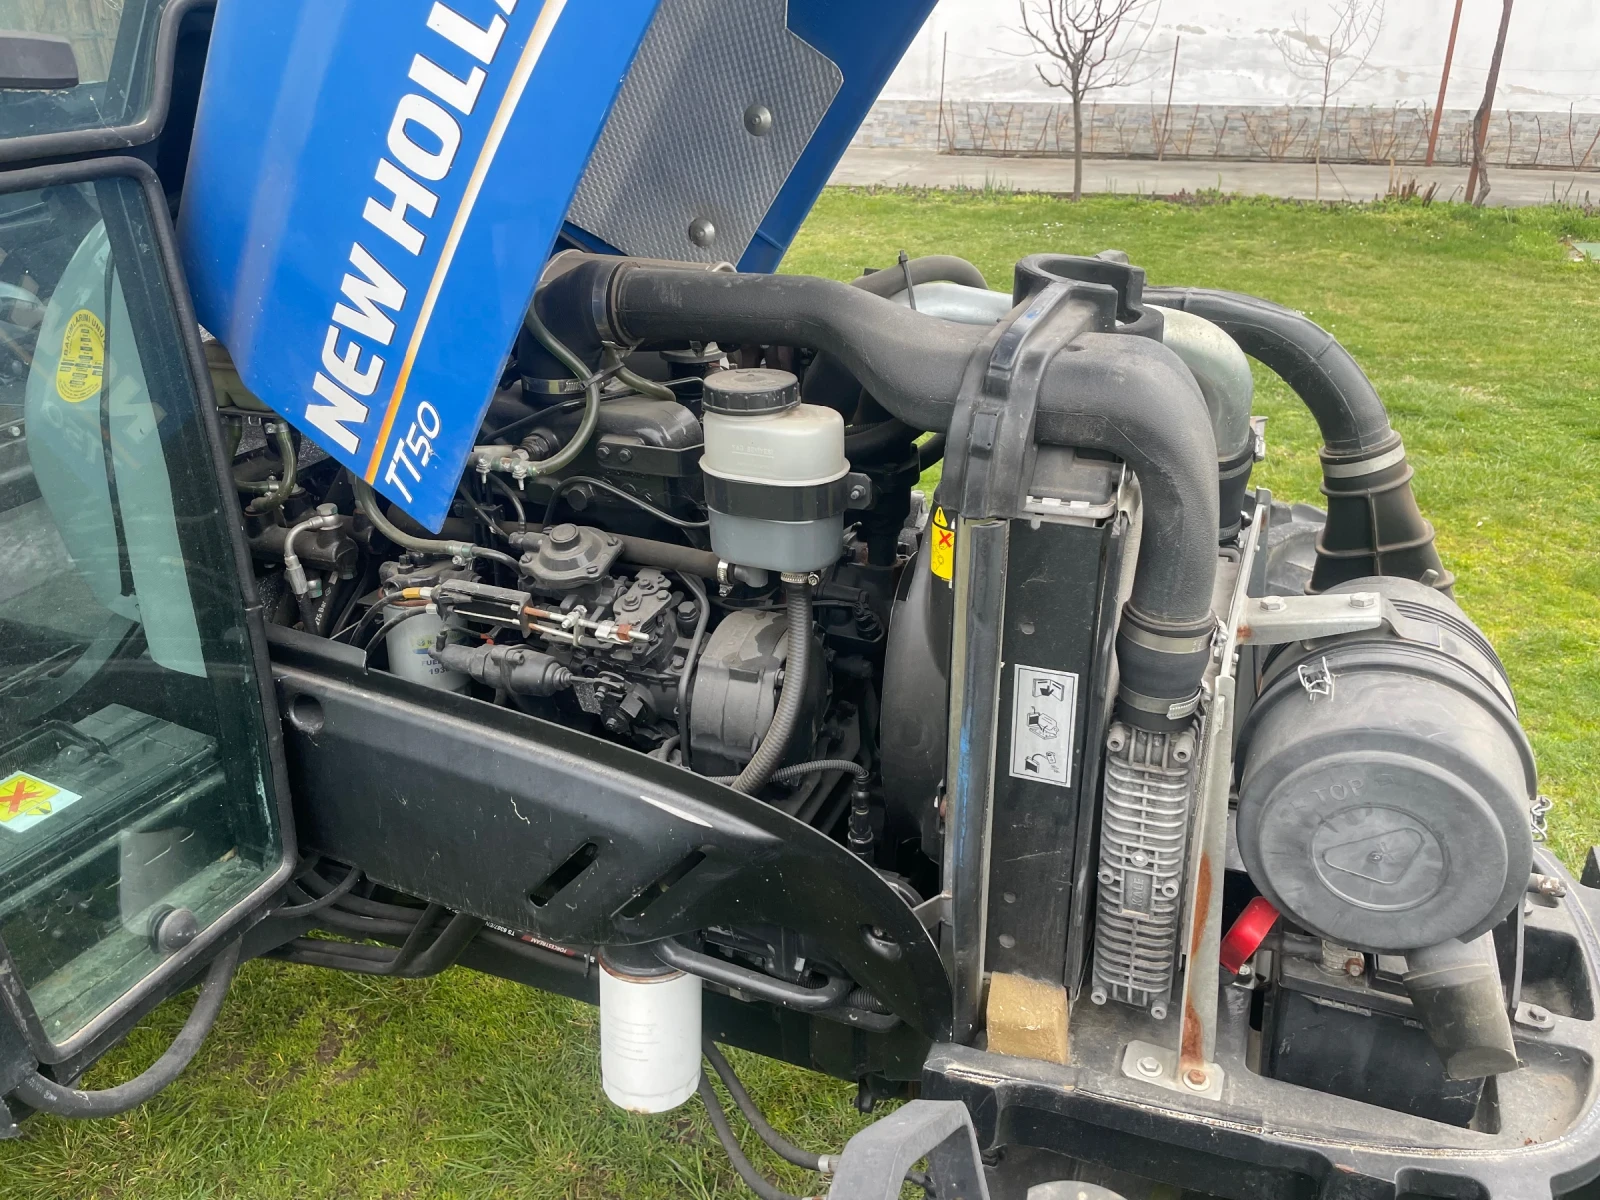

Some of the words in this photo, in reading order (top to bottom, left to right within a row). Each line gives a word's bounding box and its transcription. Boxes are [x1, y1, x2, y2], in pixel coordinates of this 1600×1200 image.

[305, 241, 408, 455] NEW
[362, 0, 518, 256] HOLL
[384, 400, 441, 504] TT50
[1309, 779, 1364, 805] TOP
[1131, 877, 1144, 907] KALE
[530, 937, 567, 953] FORCESTREAM
